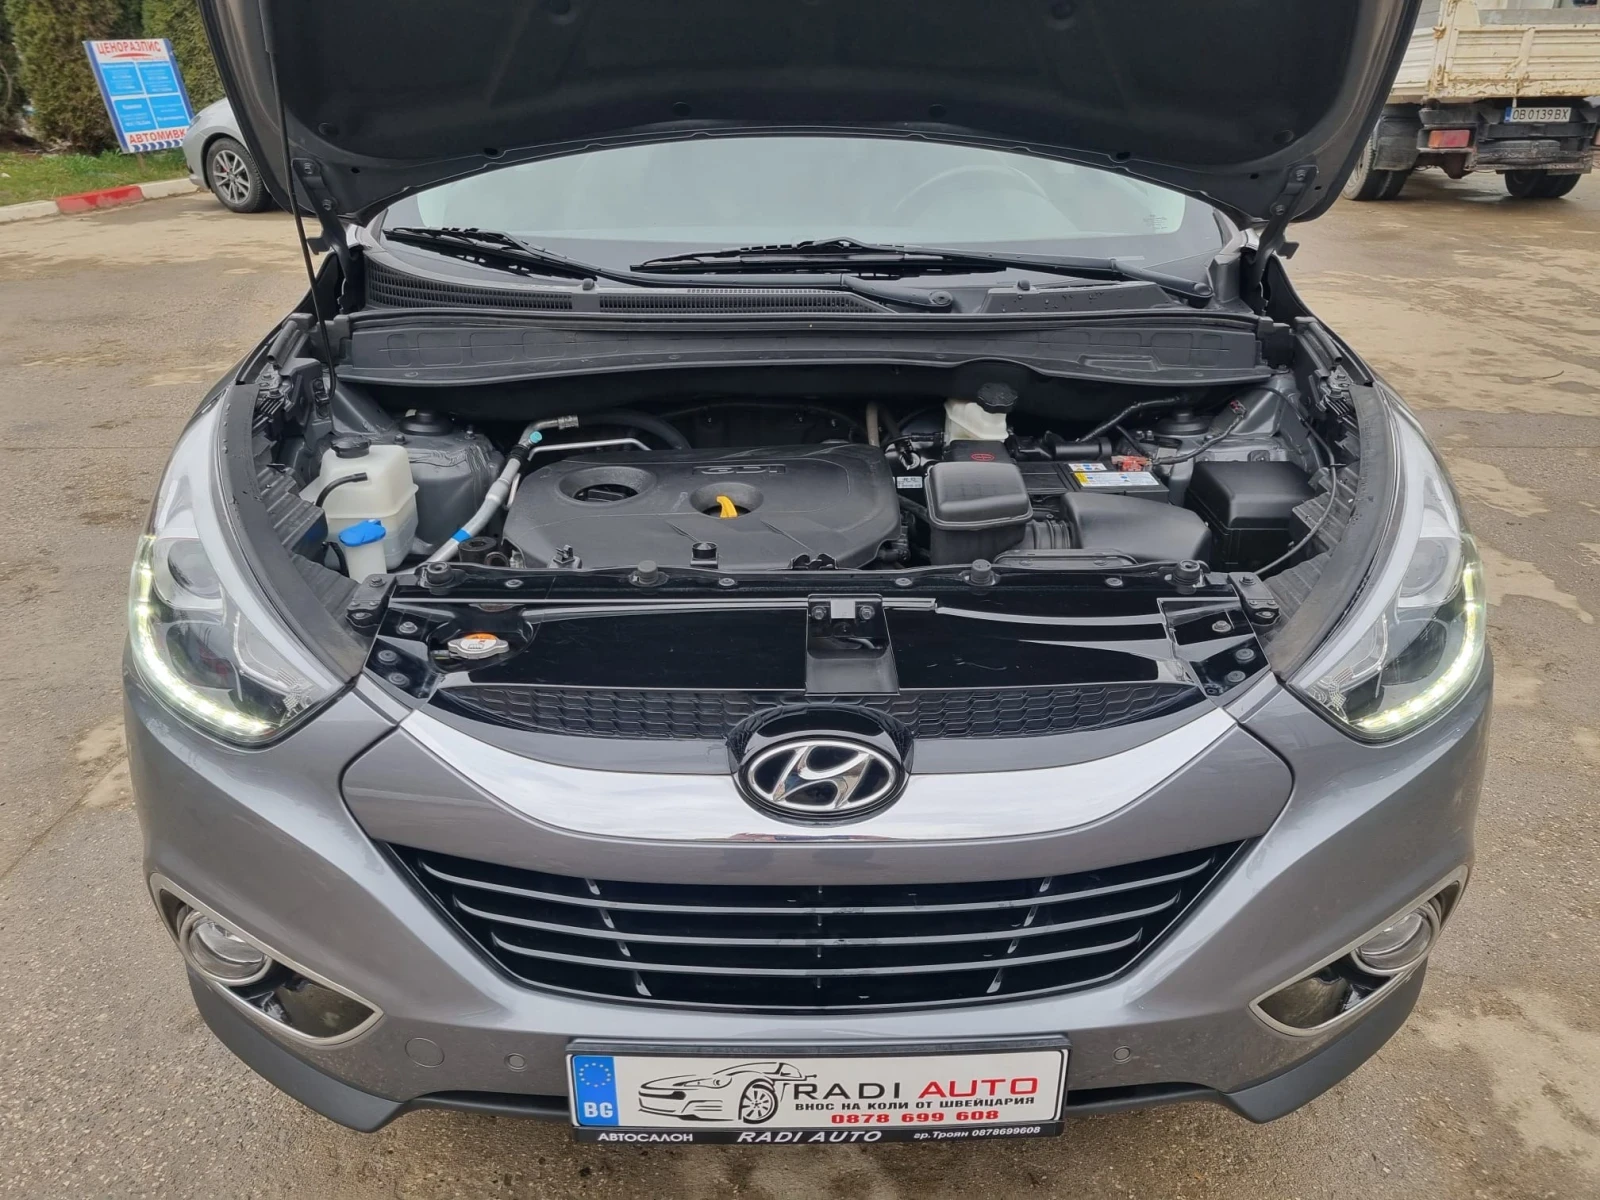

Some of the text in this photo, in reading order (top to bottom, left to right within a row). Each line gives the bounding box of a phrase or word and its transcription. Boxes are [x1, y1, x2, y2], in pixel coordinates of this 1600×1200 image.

[97, 41, 161, 54] ЦЕНОРАЗПИС
[129, 129, 187, 144] АВТОМИВК
[793, 1077, 1038, 1100] RADI AUTO
[583, 1101, 614, 1118] BG
[795, 1103, 835, 1111] ВНОС
[867, 1102, 909, 1110] КОЛИ
[915, 1101, 933, 1109] ОТ
[939, 1097, 1035, 1109] ШВЕЙЦАРИЯ
[831, 1110, 1000, 1124] 0878 699 608
[597, 1132, 694, 1142] АВТОСАЛОН
[737, 1130, 882, 1143] RADI AUTO
[971, 1126, 1041, 1137] 0878699608
